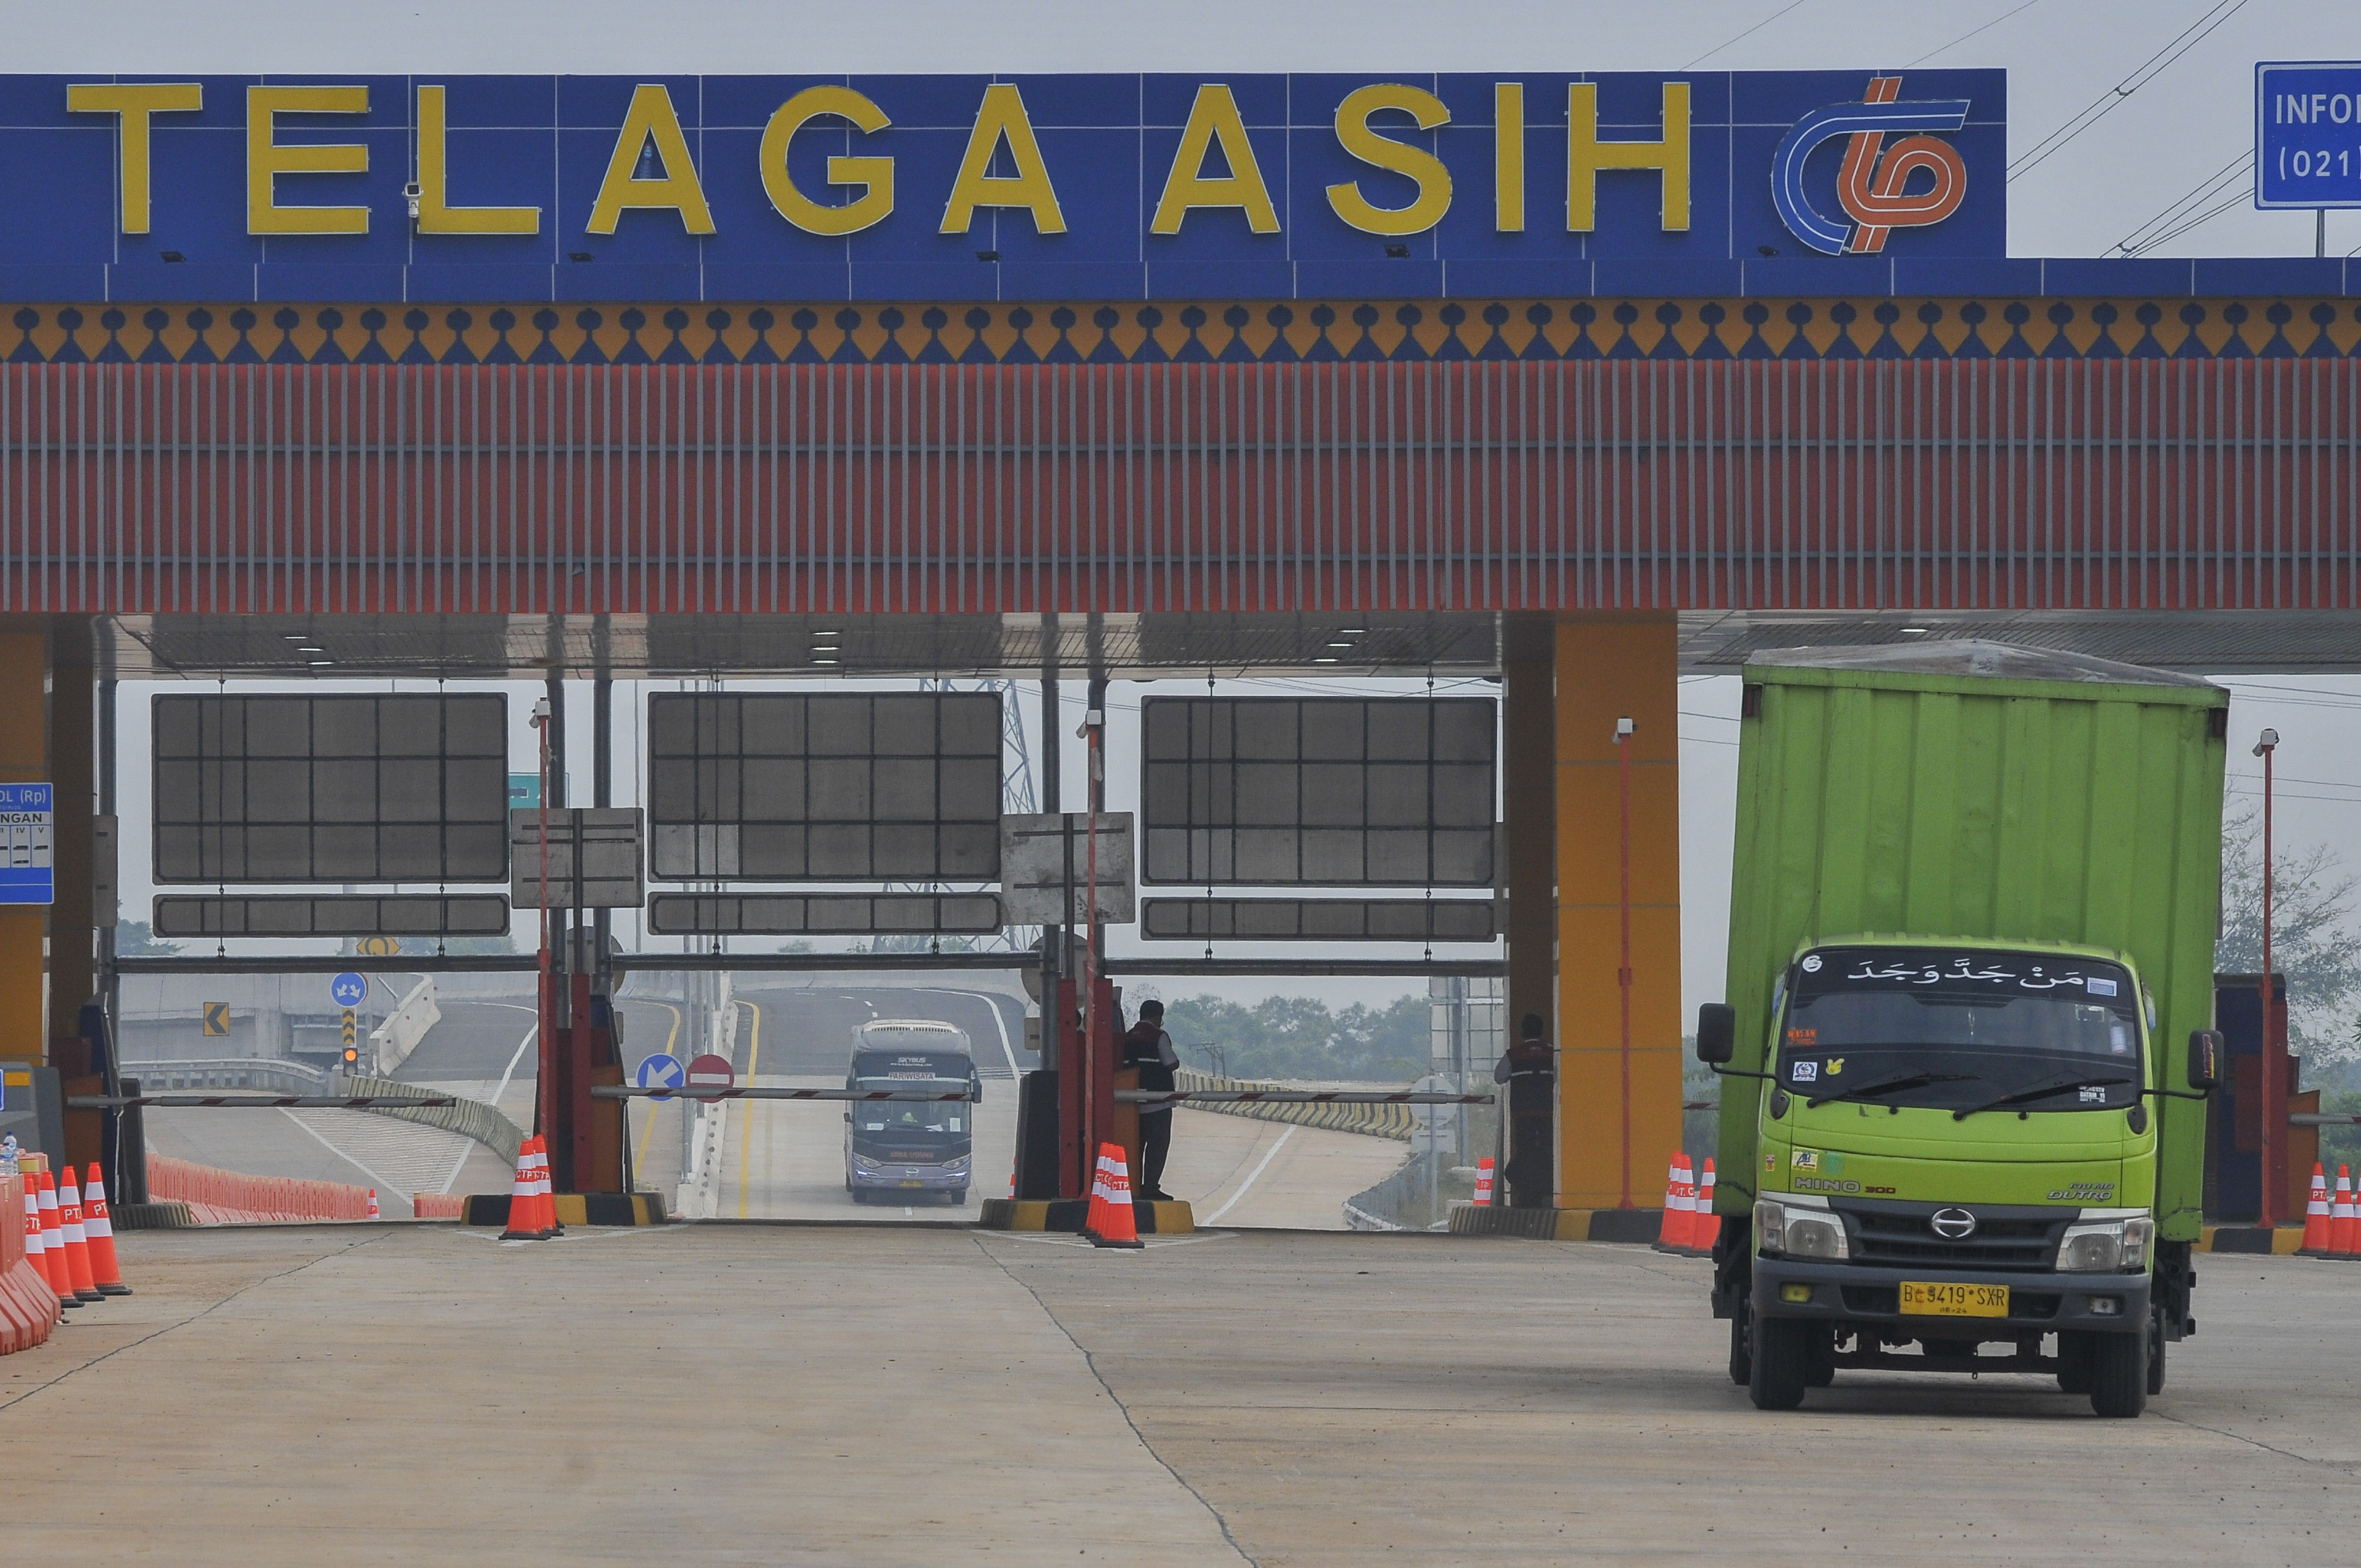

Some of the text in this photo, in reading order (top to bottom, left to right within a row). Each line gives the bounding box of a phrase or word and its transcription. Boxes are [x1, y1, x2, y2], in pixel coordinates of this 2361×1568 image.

[66, 81, 1693, 236] TELAGA ASIH
[20, 788, 46, 806] (Rp)
[1112, 1181, 1129, 1190] CTP
[1795, 1177, 1896, 1194] HINO 300
[2047, 1191, 2112, 1201] DUTRO
[1905, 1285, 2005, 1306] B 9419 SXR
